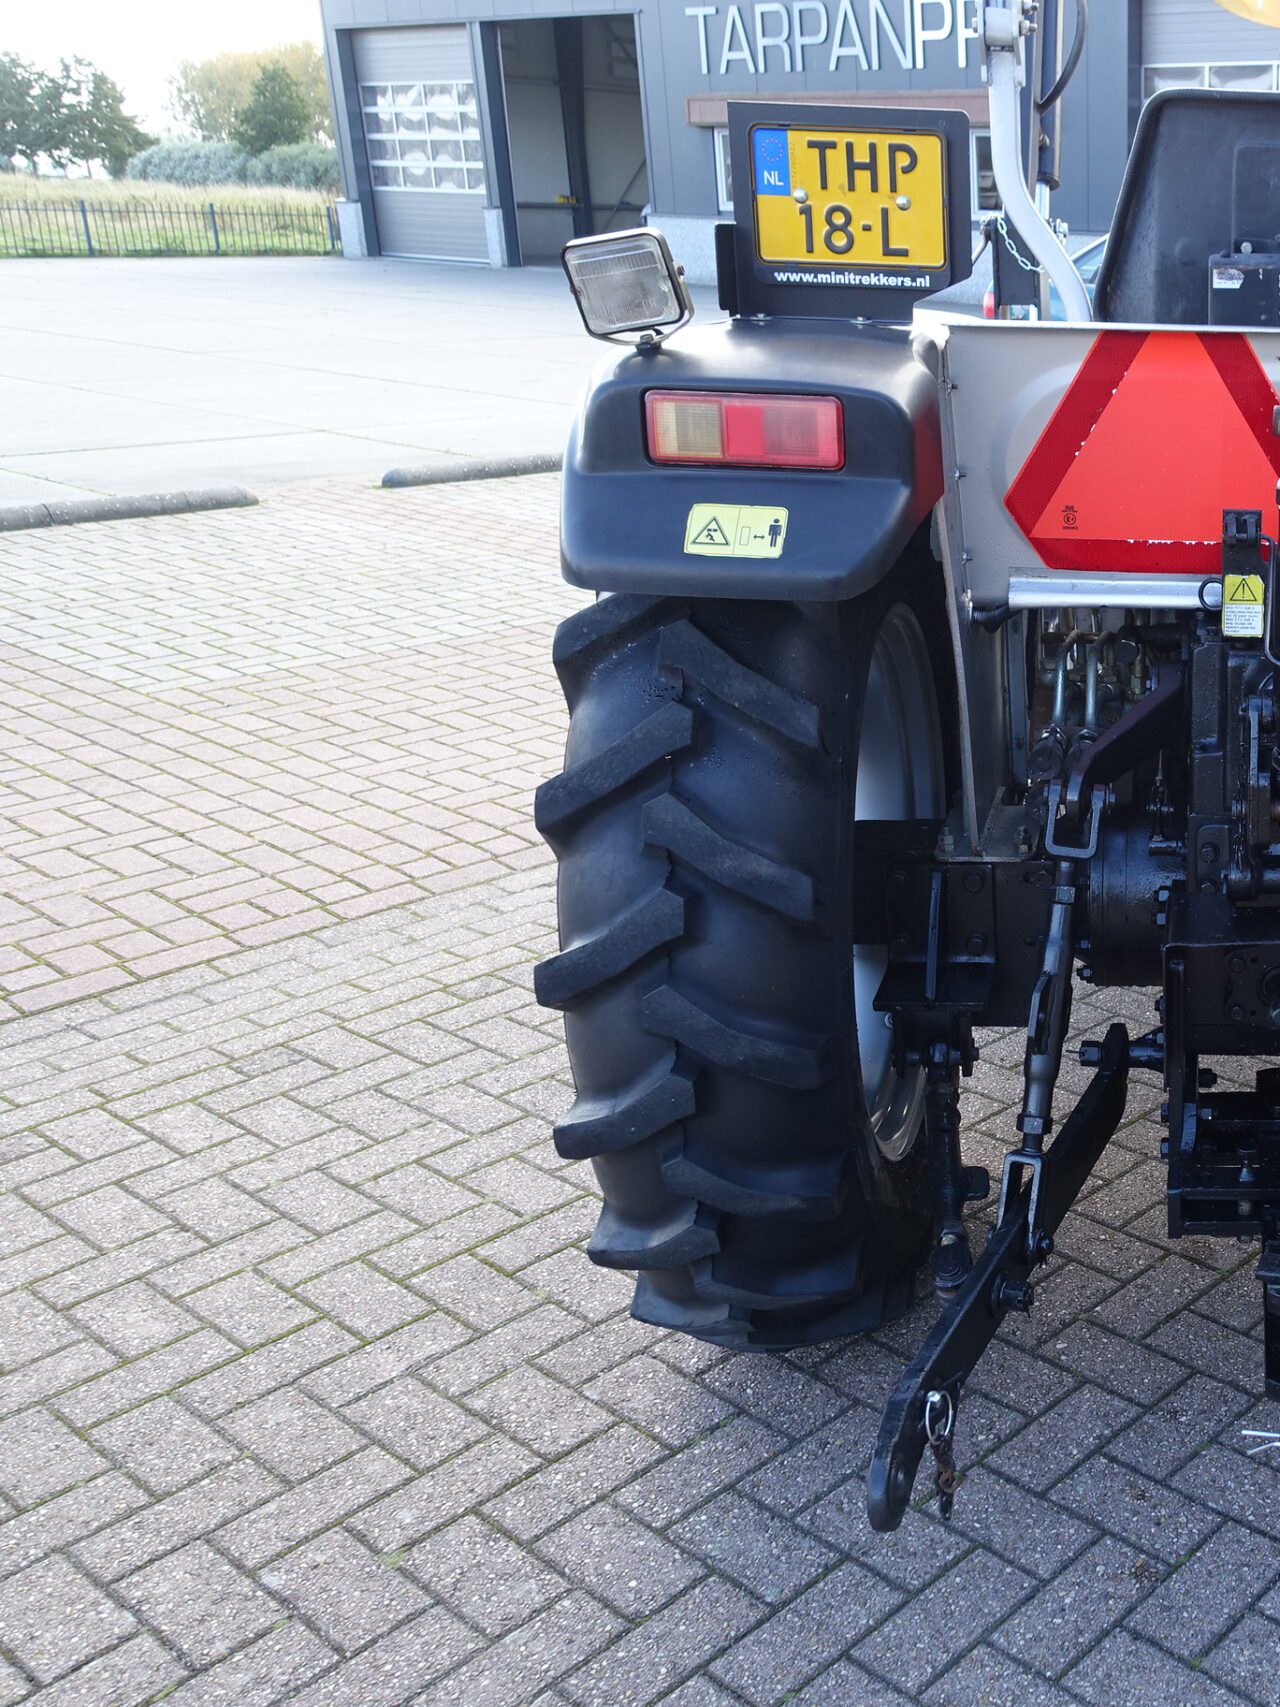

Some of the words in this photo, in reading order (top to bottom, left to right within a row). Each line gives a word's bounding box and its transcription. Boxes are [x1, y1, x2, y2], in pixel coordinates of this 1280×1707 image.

[763, 170, 784, 186] NL
[806, 140, 918, 193] THP
[798, 204, 910, 258] 18-L
[773, 271, 931, 288] www.minitrekkers.nl
